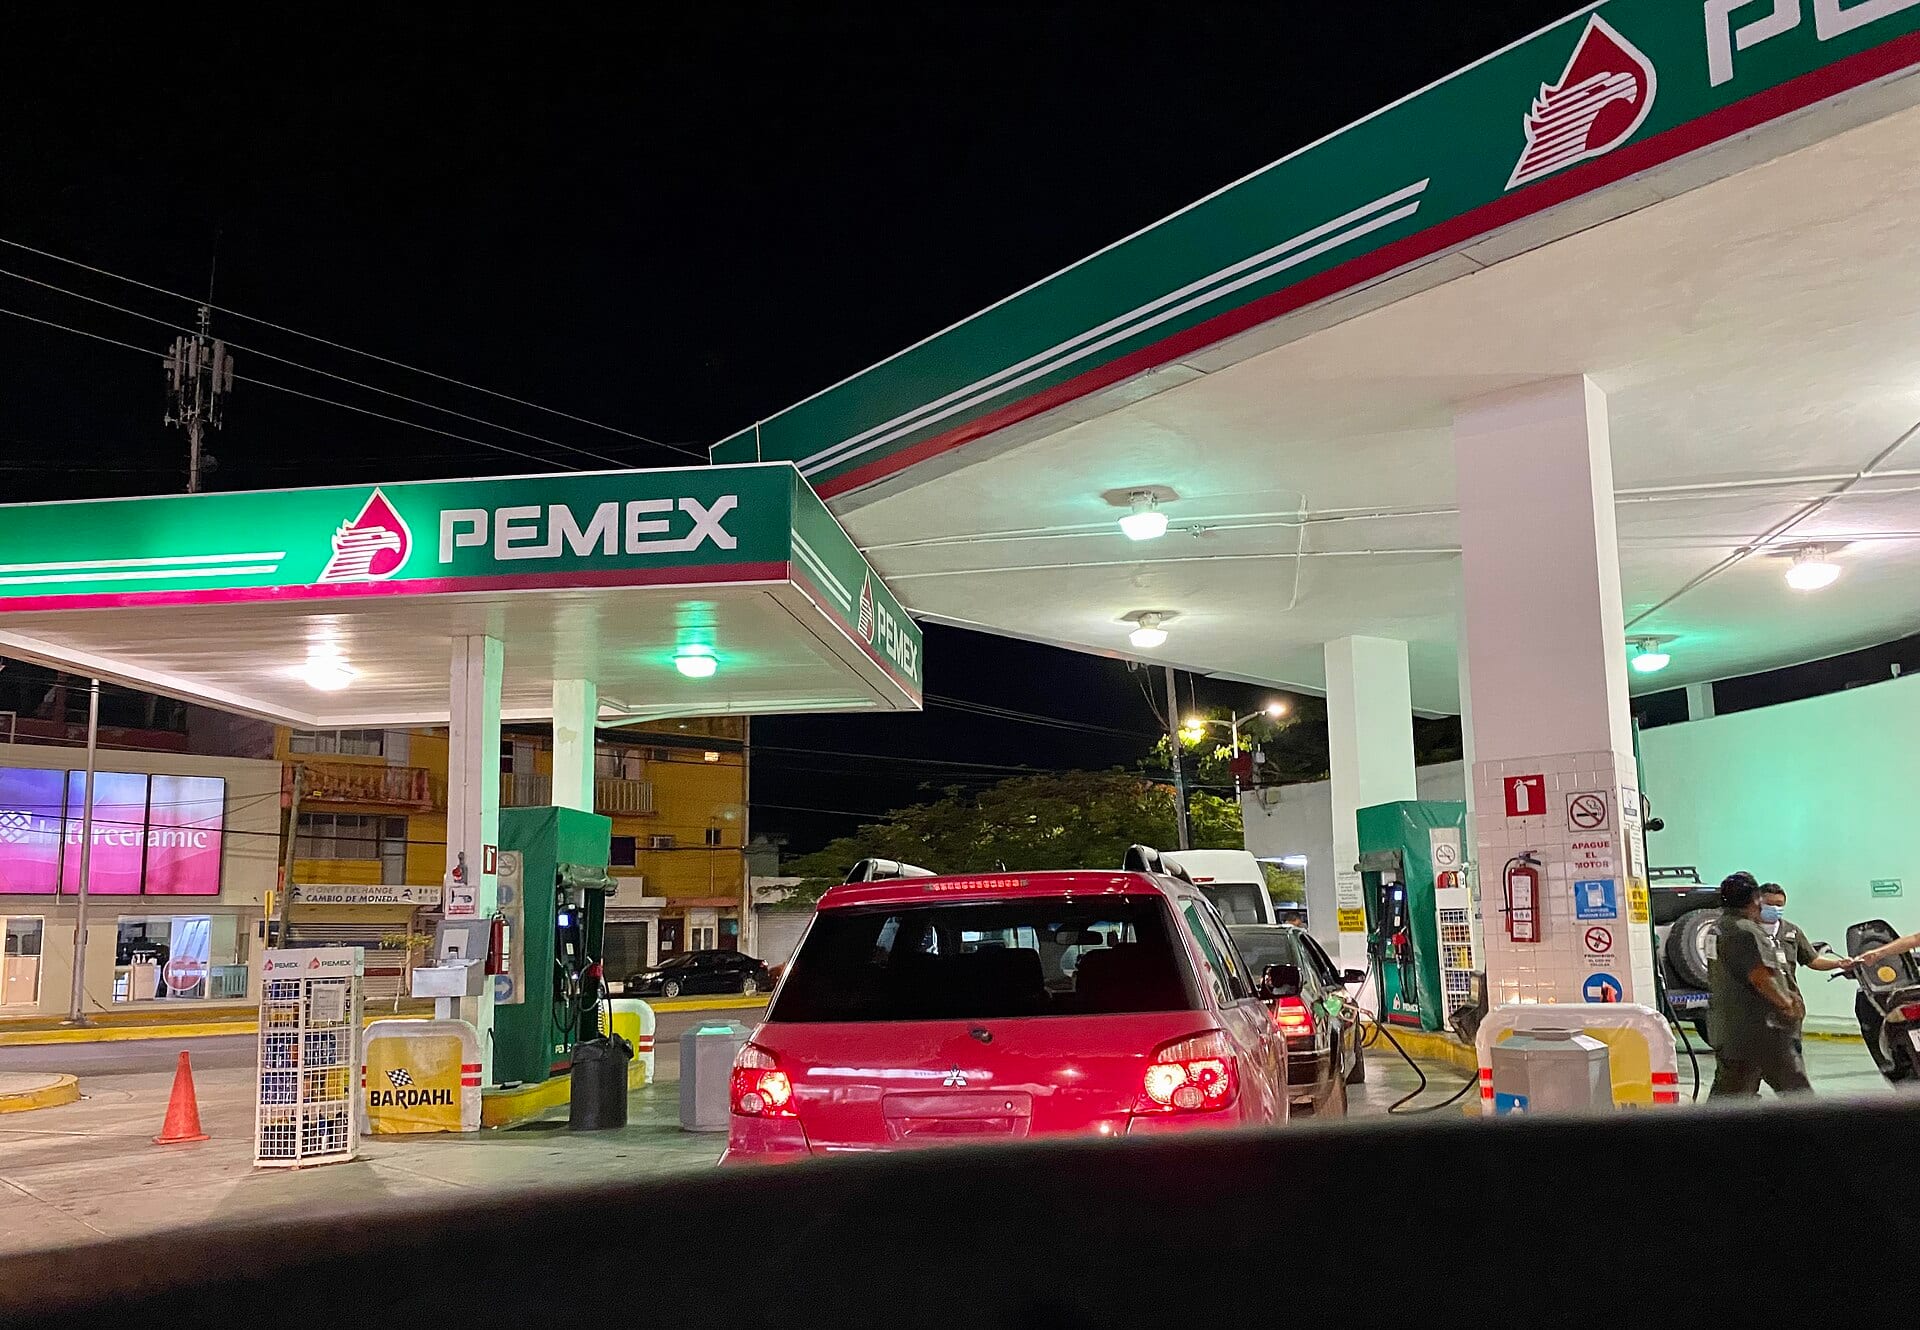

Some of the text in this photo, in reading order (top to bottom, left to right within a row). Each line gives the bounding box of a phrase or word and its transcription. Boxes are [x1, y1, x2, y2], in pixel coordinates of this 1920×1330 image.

[438, 495, 738, 564] PEMEX
[877, 600, 918, 683] PEMEX
[1572, 841, 1610, 849] APAGUE
[306, 894, 399, 903] CAMBIO DE MONEDA
[370, 1089, 454, 1109] BARDAHL
